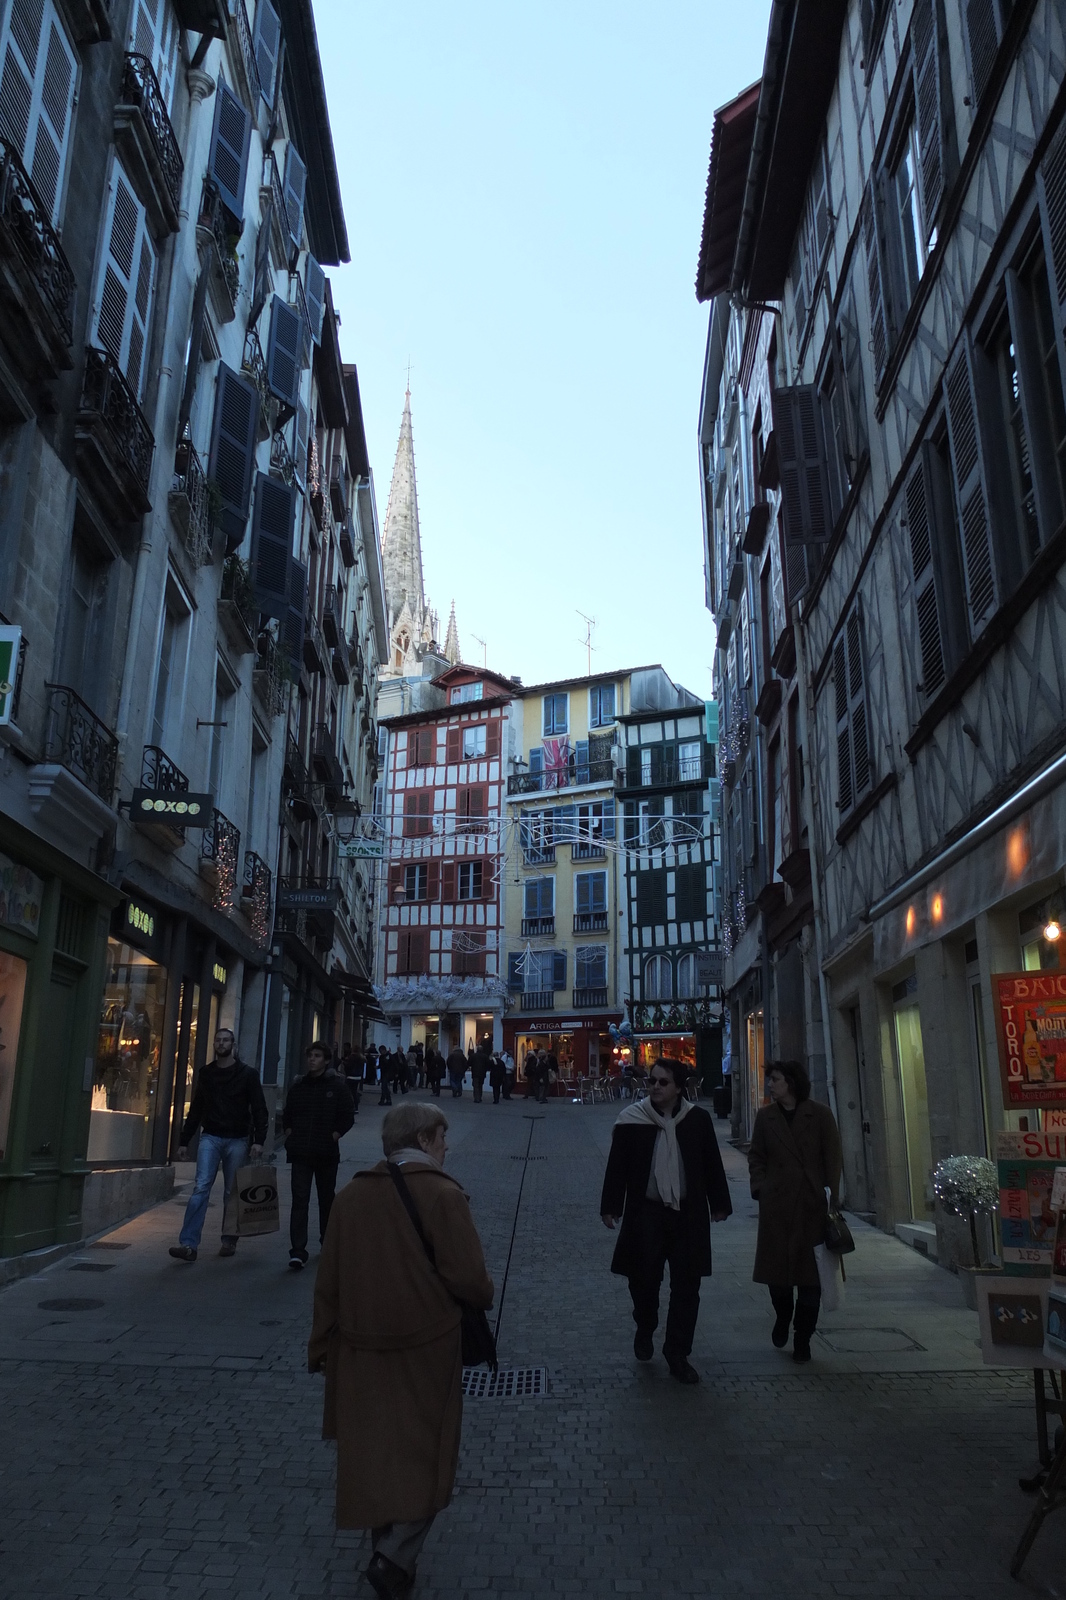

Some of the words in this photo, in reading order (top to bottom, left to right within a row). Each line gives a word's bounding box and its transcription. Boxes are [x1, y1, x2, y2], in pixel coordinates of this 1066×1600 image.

[346, 846, 381, 856] SPORTS
[289, 894, 328, 903] SHILTON
[1002, 1004, 1022, 1076] TORO
[1023, 1133, 1066, 1159] SU
[244, 1205, 278, 1214] SALOMON
[1018, 1249, 1041, 1261] LES
